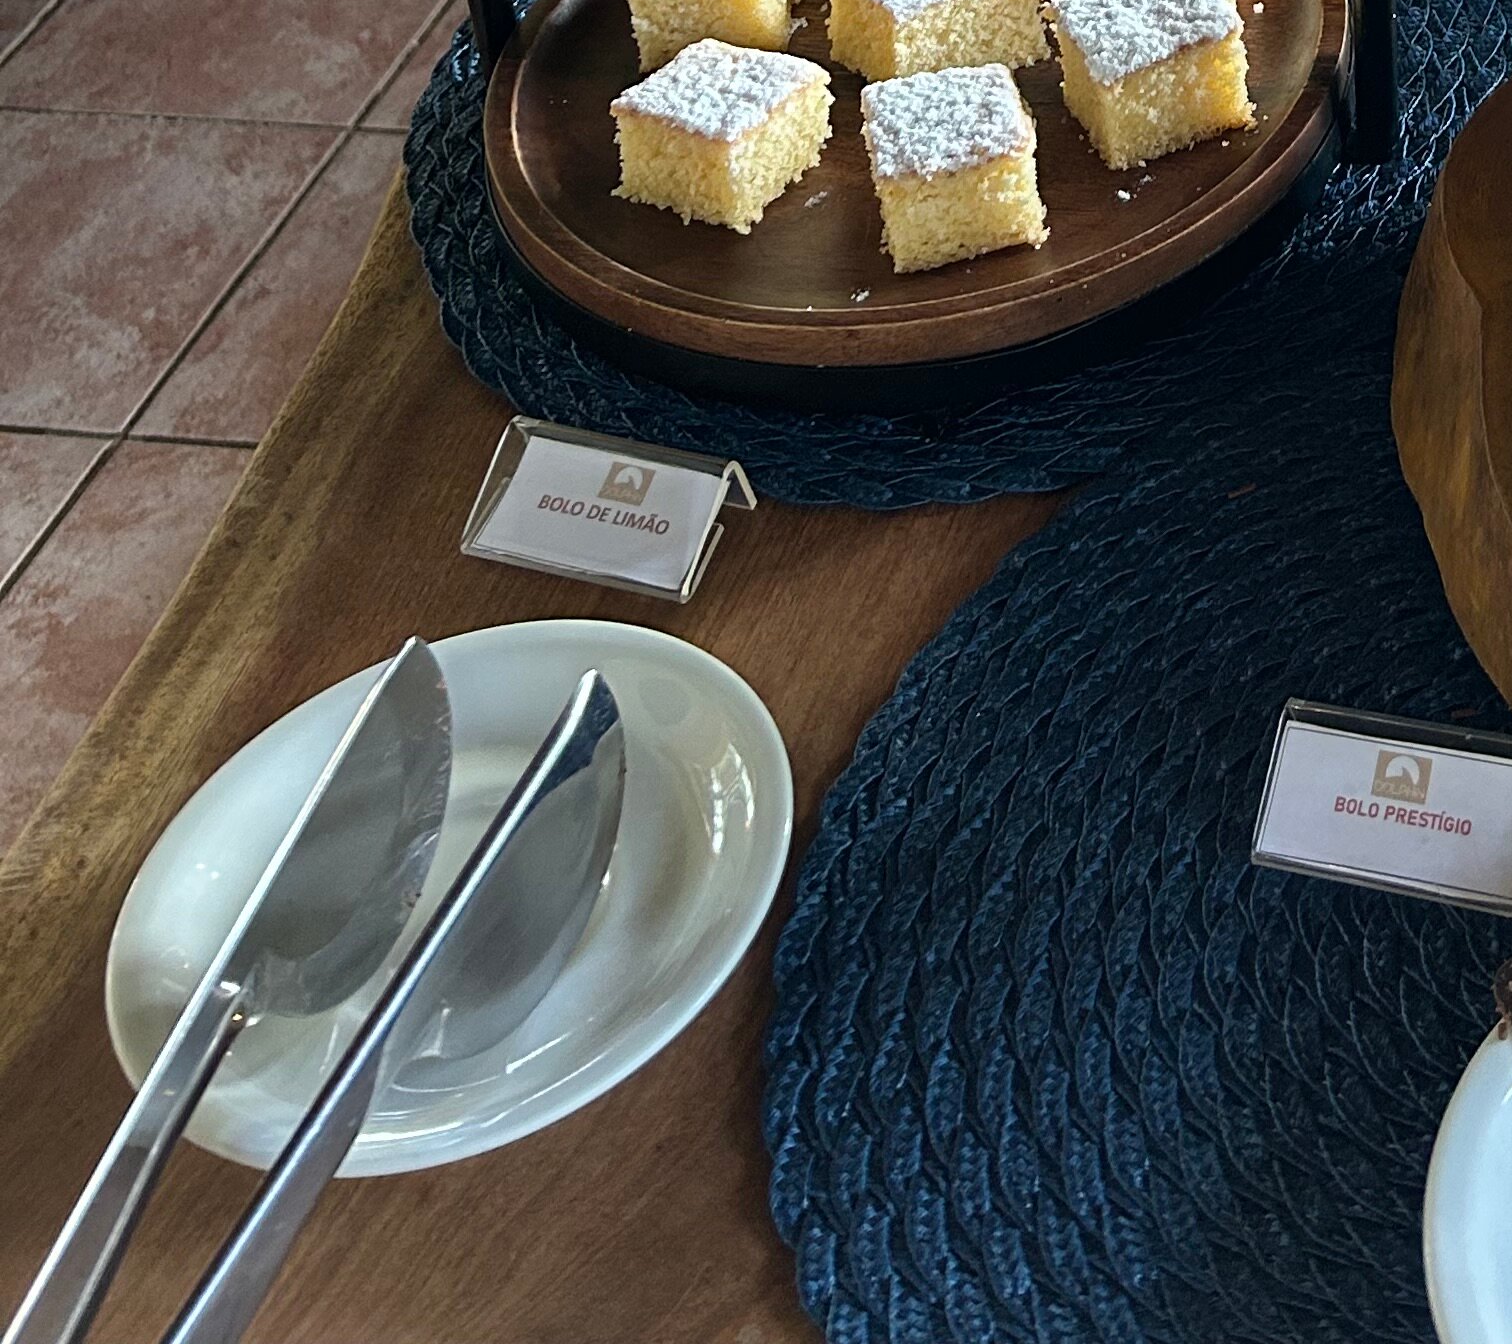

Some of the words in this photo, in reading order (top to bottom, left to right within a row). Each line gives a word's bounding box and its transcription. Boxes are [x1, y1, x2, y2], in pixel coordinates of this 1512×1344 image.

[537, 494, 585, 516] BOLO
[586, 504, 612, 522] DE
[612, 510, 670, 535] LIMÃO
[1334, 796, 1379, 818] BOLO
[1384, 805, 1472, 836] PRESTÍGIO
